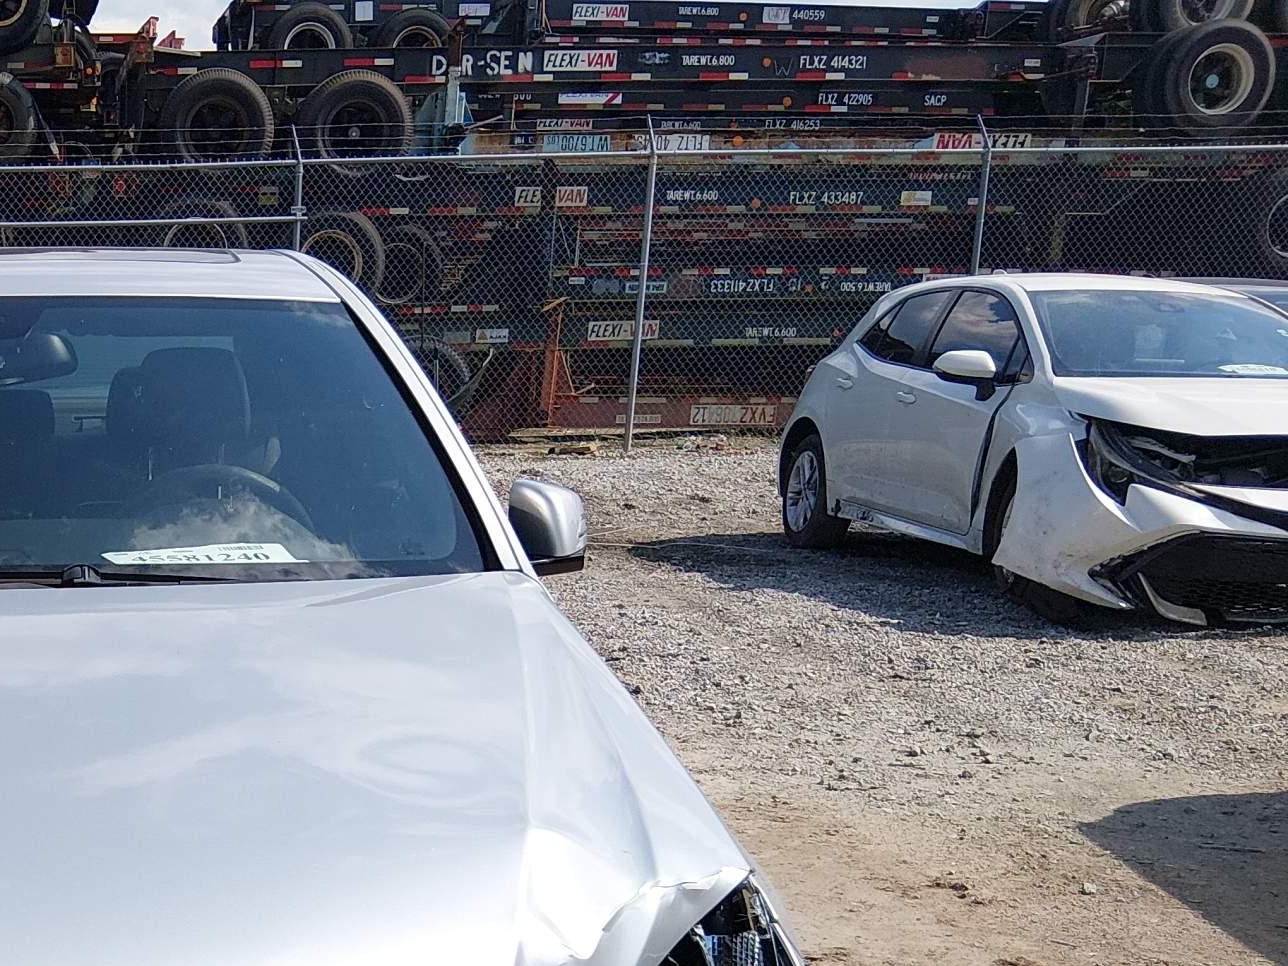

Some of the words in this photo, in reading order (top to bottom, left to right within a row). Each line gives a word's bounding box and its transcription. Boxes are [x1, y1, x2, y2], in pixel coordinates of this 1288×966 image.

[573, 5, 628, 18] FLEXI-VAN
[792, 9, 825, 21] 440559
[545, 51, 617, 69] FLEXI-VAN
[800, 55, 828, 69] FLXZ
[830, 55, 867, 69] 414321
[818, 93, 837, 105] FLXZ
[843, 93, 873, 105] 422905
[924, 95, 947, 107] SACP
[765, 119, 786, 129] FLXZ
[791, 119, 821, 130] 416253
[790, 192, 817, 205] FLXZ
[821, 192, 864, 205] 433487
[746, 279, 775, 292] FLXZ
[131, 552, 271, 562] 45581240
